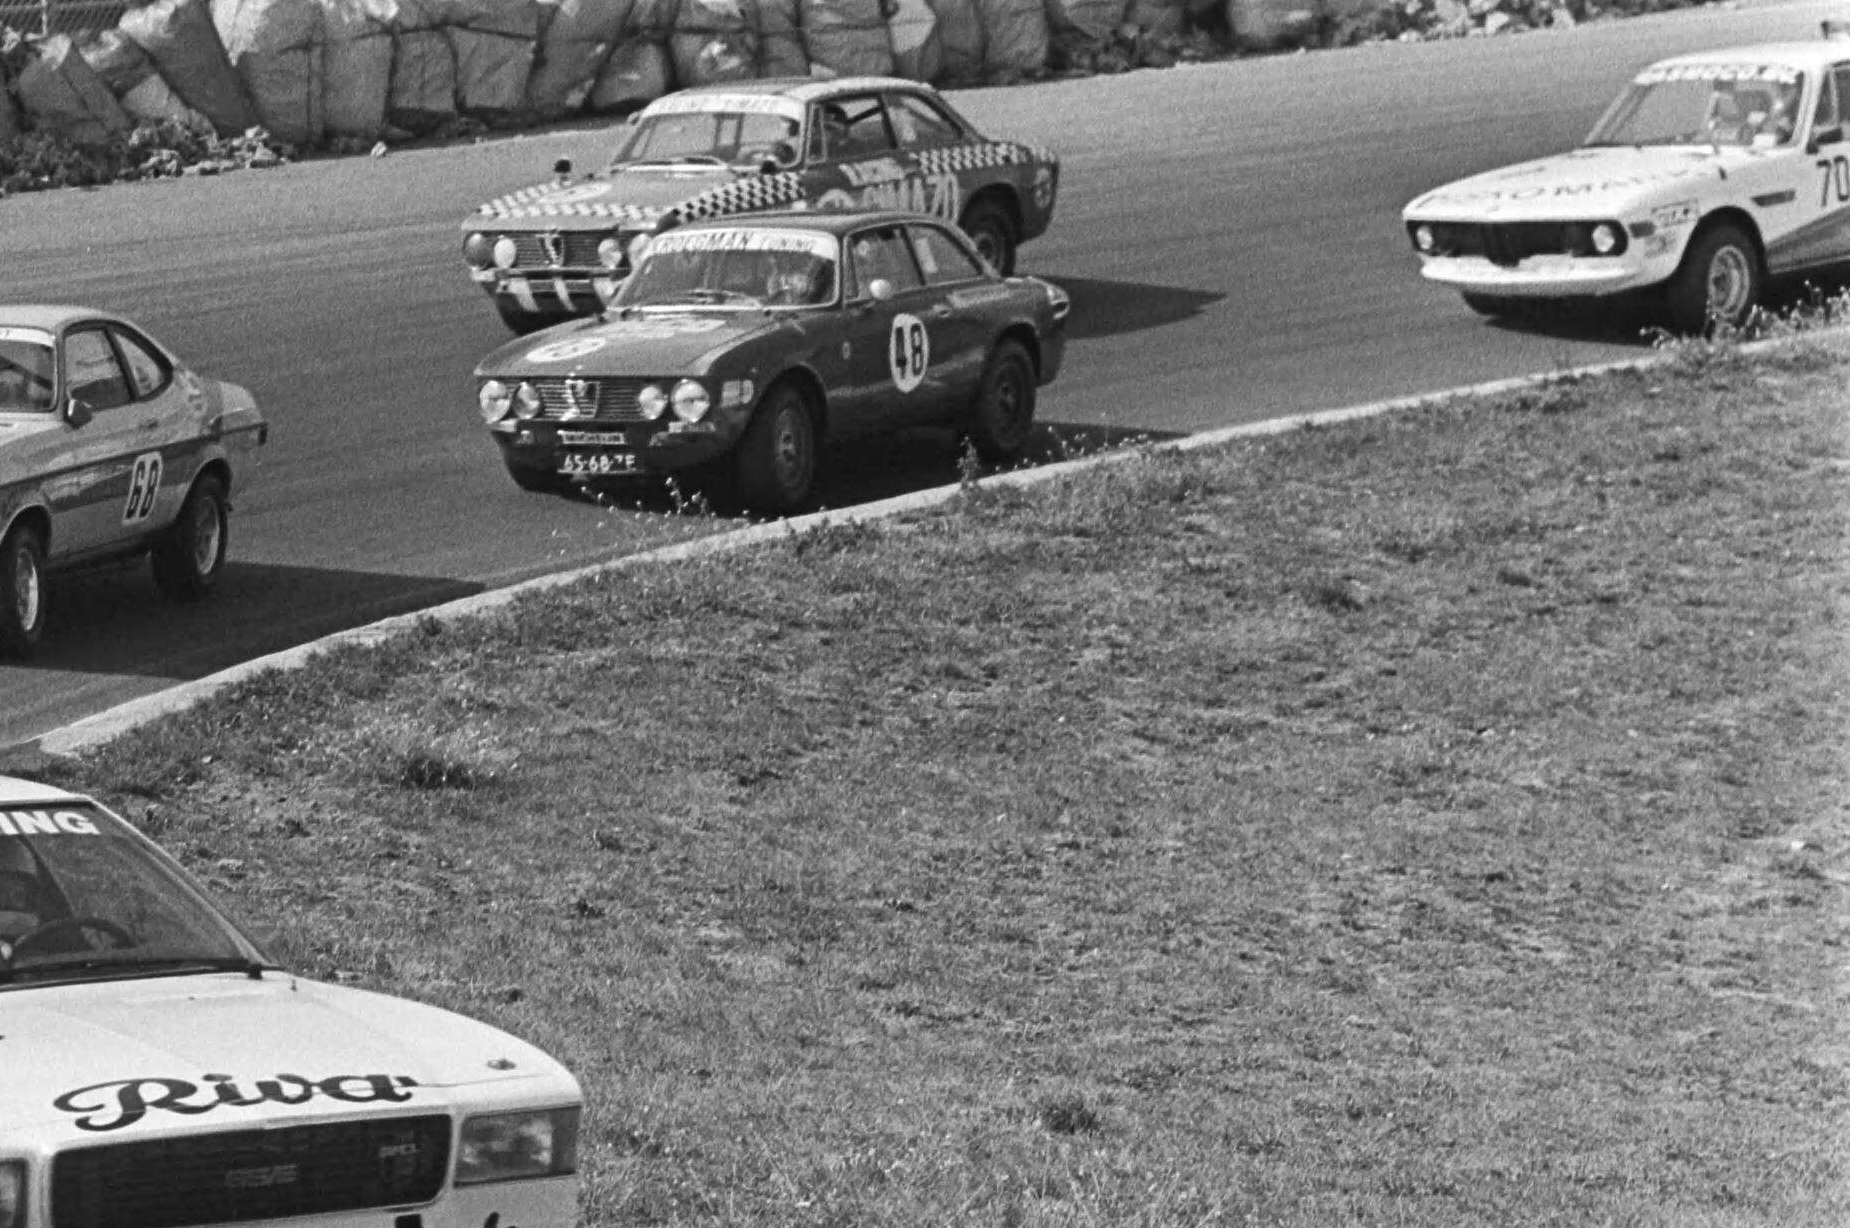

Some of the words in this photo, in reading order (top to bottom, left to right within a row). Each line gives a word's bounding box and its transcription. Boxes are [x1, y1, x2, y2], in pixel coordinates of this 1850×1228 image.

[1816, 155, 1849, 206] 70
[894, 323, 924, 379] 48
[53, 1073, 419, 1132] Riva
